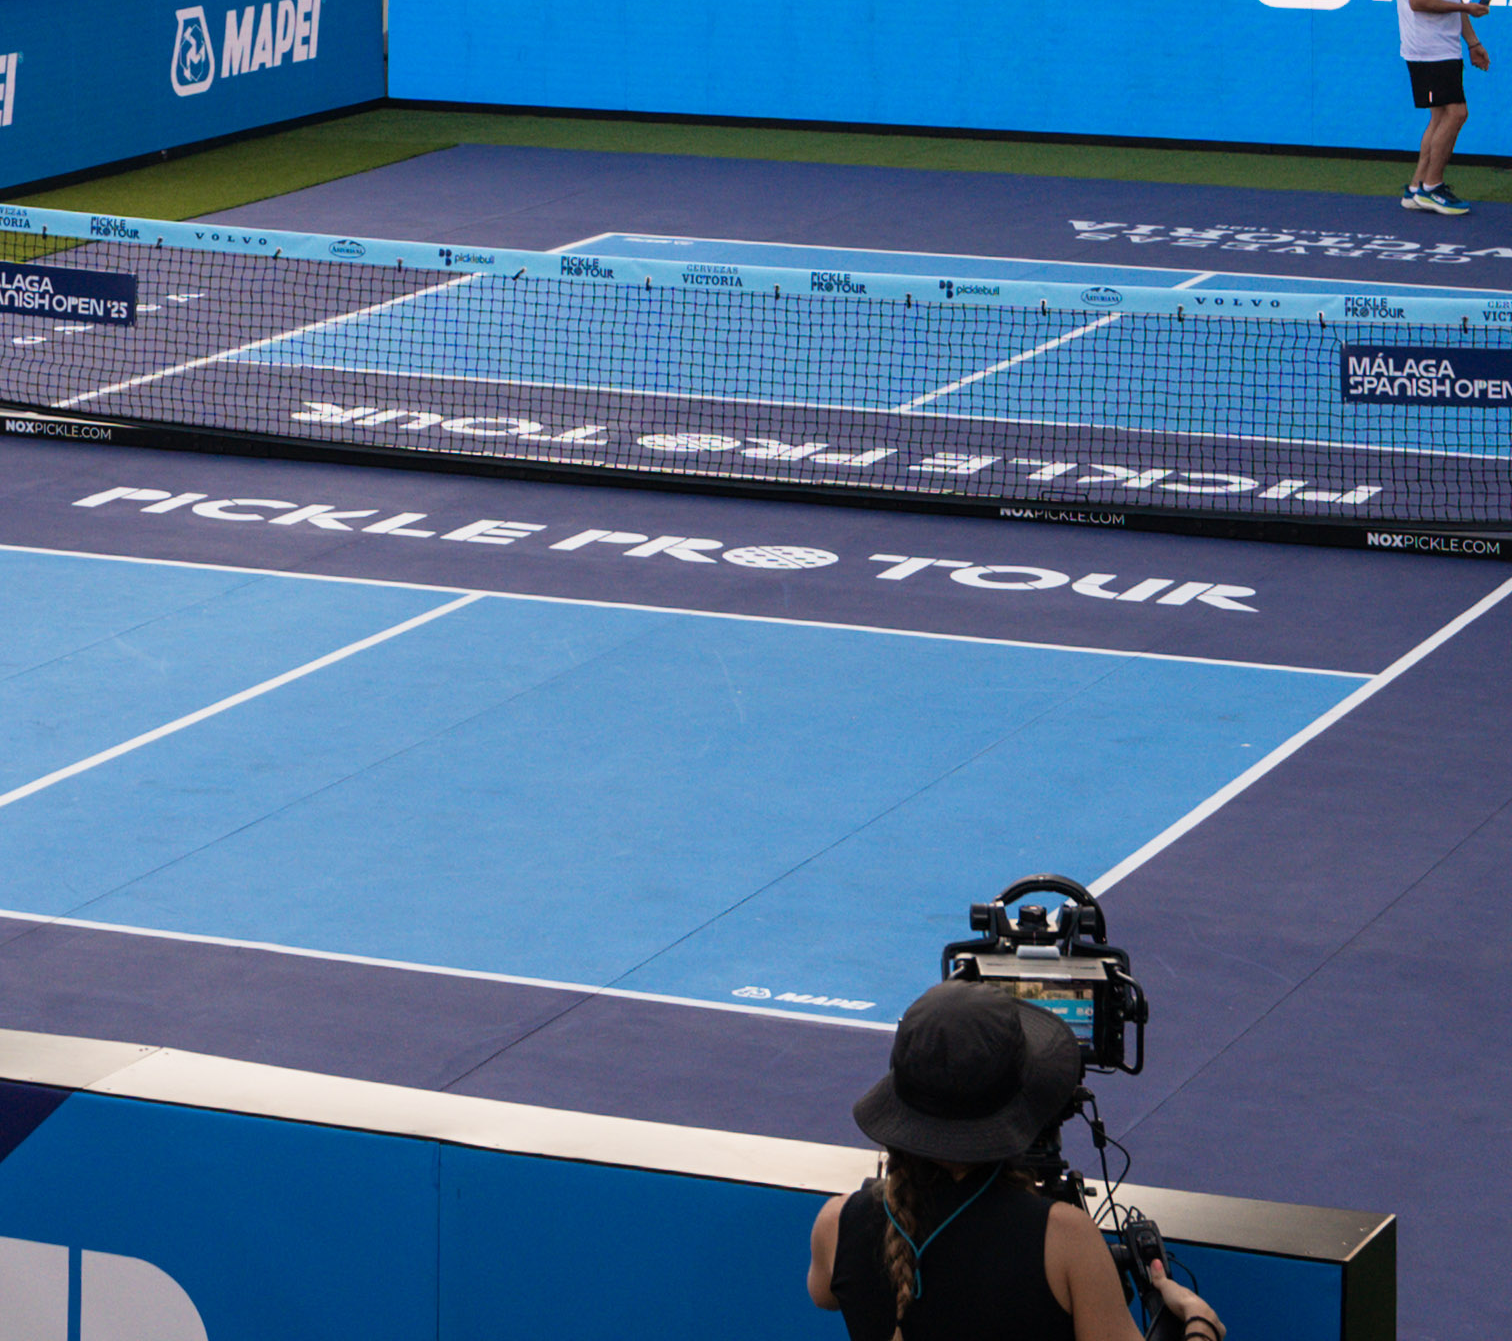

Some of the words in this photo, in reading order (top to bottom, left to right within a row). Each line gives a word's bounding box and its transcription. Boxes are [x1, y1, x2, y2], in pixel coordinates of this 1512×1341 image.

[90, 217, 126, 229] PICKLE
[195, 232, 267, 246] VOLVO
[454, 252, 495, 265] picklebull
[561, 255, 599, 268] PICKLE
[686, 263, 739, 275] CERVEZAS
[682, 273, 743, 287] VICTORIA
[811, 271, 851, 284] PICKLE
[956, 284, 1000, 297] picklebull
[52, 295, 104, 316] OPEN
[1195, 296, 1280, 310] VOLVO
[1344, 296, 1388, 308] PICKLE
[1348, 353, 1455, 378] MÁLAGA
[1348, 377, 1451, 398] SPANISH
[5, 418, 112, 441] NOXPICKLE.COM
[291, 400, 608, 447] TOUR
[909, 450, 1382, 506] PICKLE
[1000, 506, 1125, 526] NOXPICKLE.COM
[72, 487, 547, 546] PICKLE
[868, 554, 1260, 614] TOUR
[1367, 532, 1501, 555] NOXPICKLE.COM
[774, 992, 876, 1010] MAPEI
